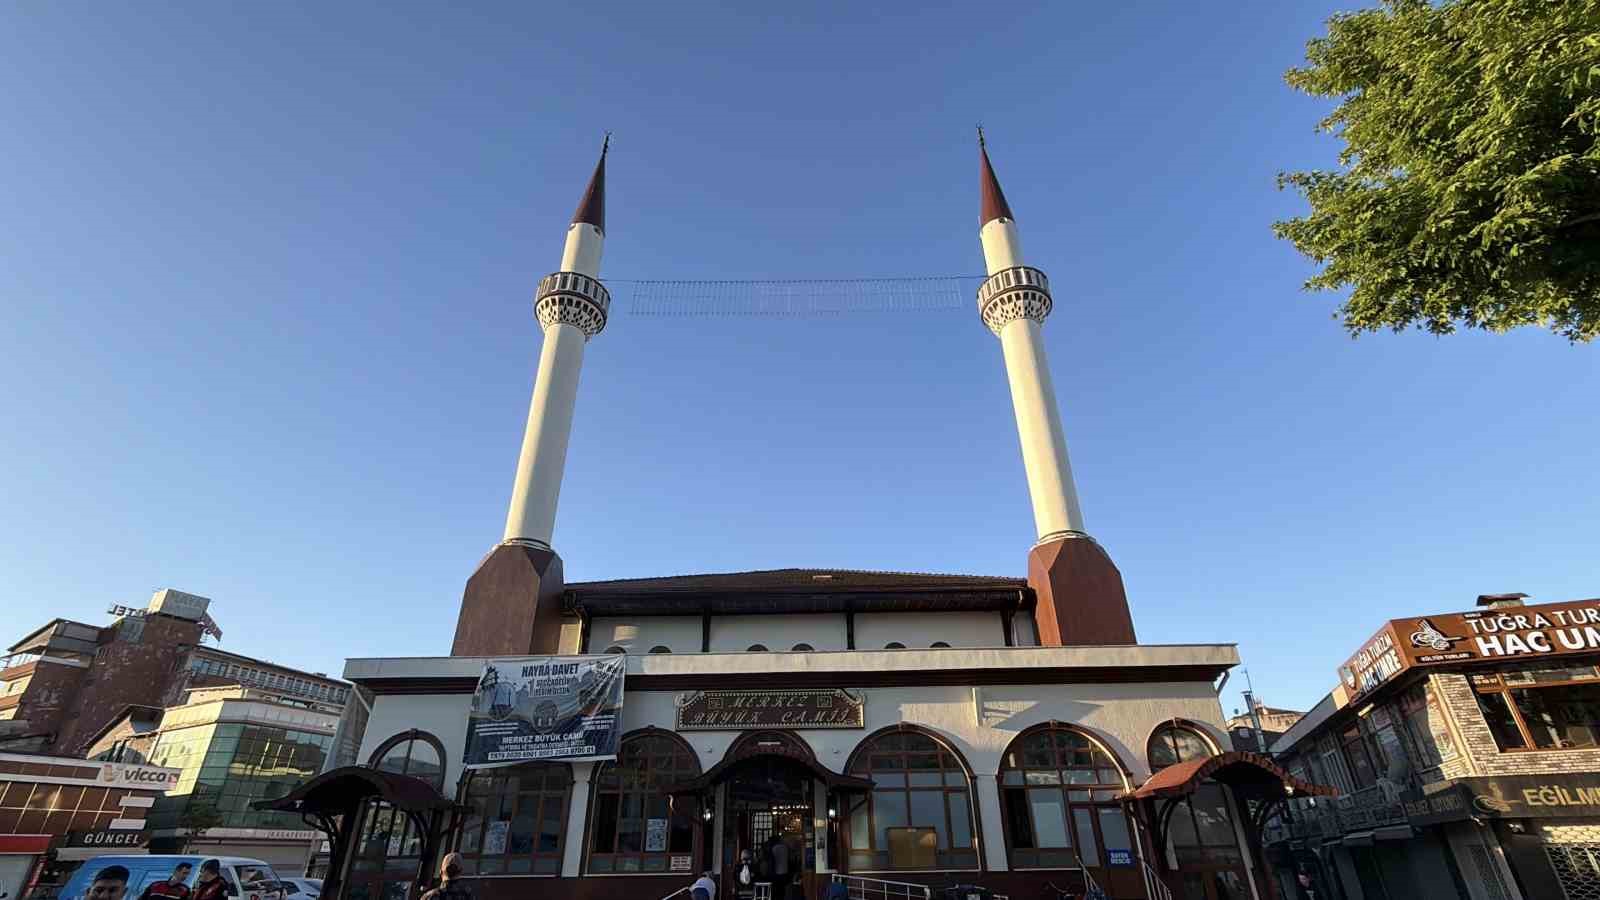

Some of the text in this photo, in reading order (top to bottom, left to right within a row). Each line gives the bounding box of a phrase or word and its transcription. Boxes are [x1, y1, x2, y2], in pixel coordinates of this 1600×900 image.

[1466, 613, 1550, 634] TUĞRA
[1475, 631, 1551, 657] HAC
[521, 664, 550, 678] HAYRA
[552, 663, 579, 676] DAVET
[1359, 649, 1402, 693] HAC UMRE
[728, 695, 809, 708] MERKEZ
[692, 709, 763, 725] BÜYÜK
[502, 736, 533, 744] MERKEZ
[535, 734, 560, 743] BÜYÜK
[1522, 784, 1600, 806] EĞİLM
[84, 832, 140, 844] GÜNCEL
